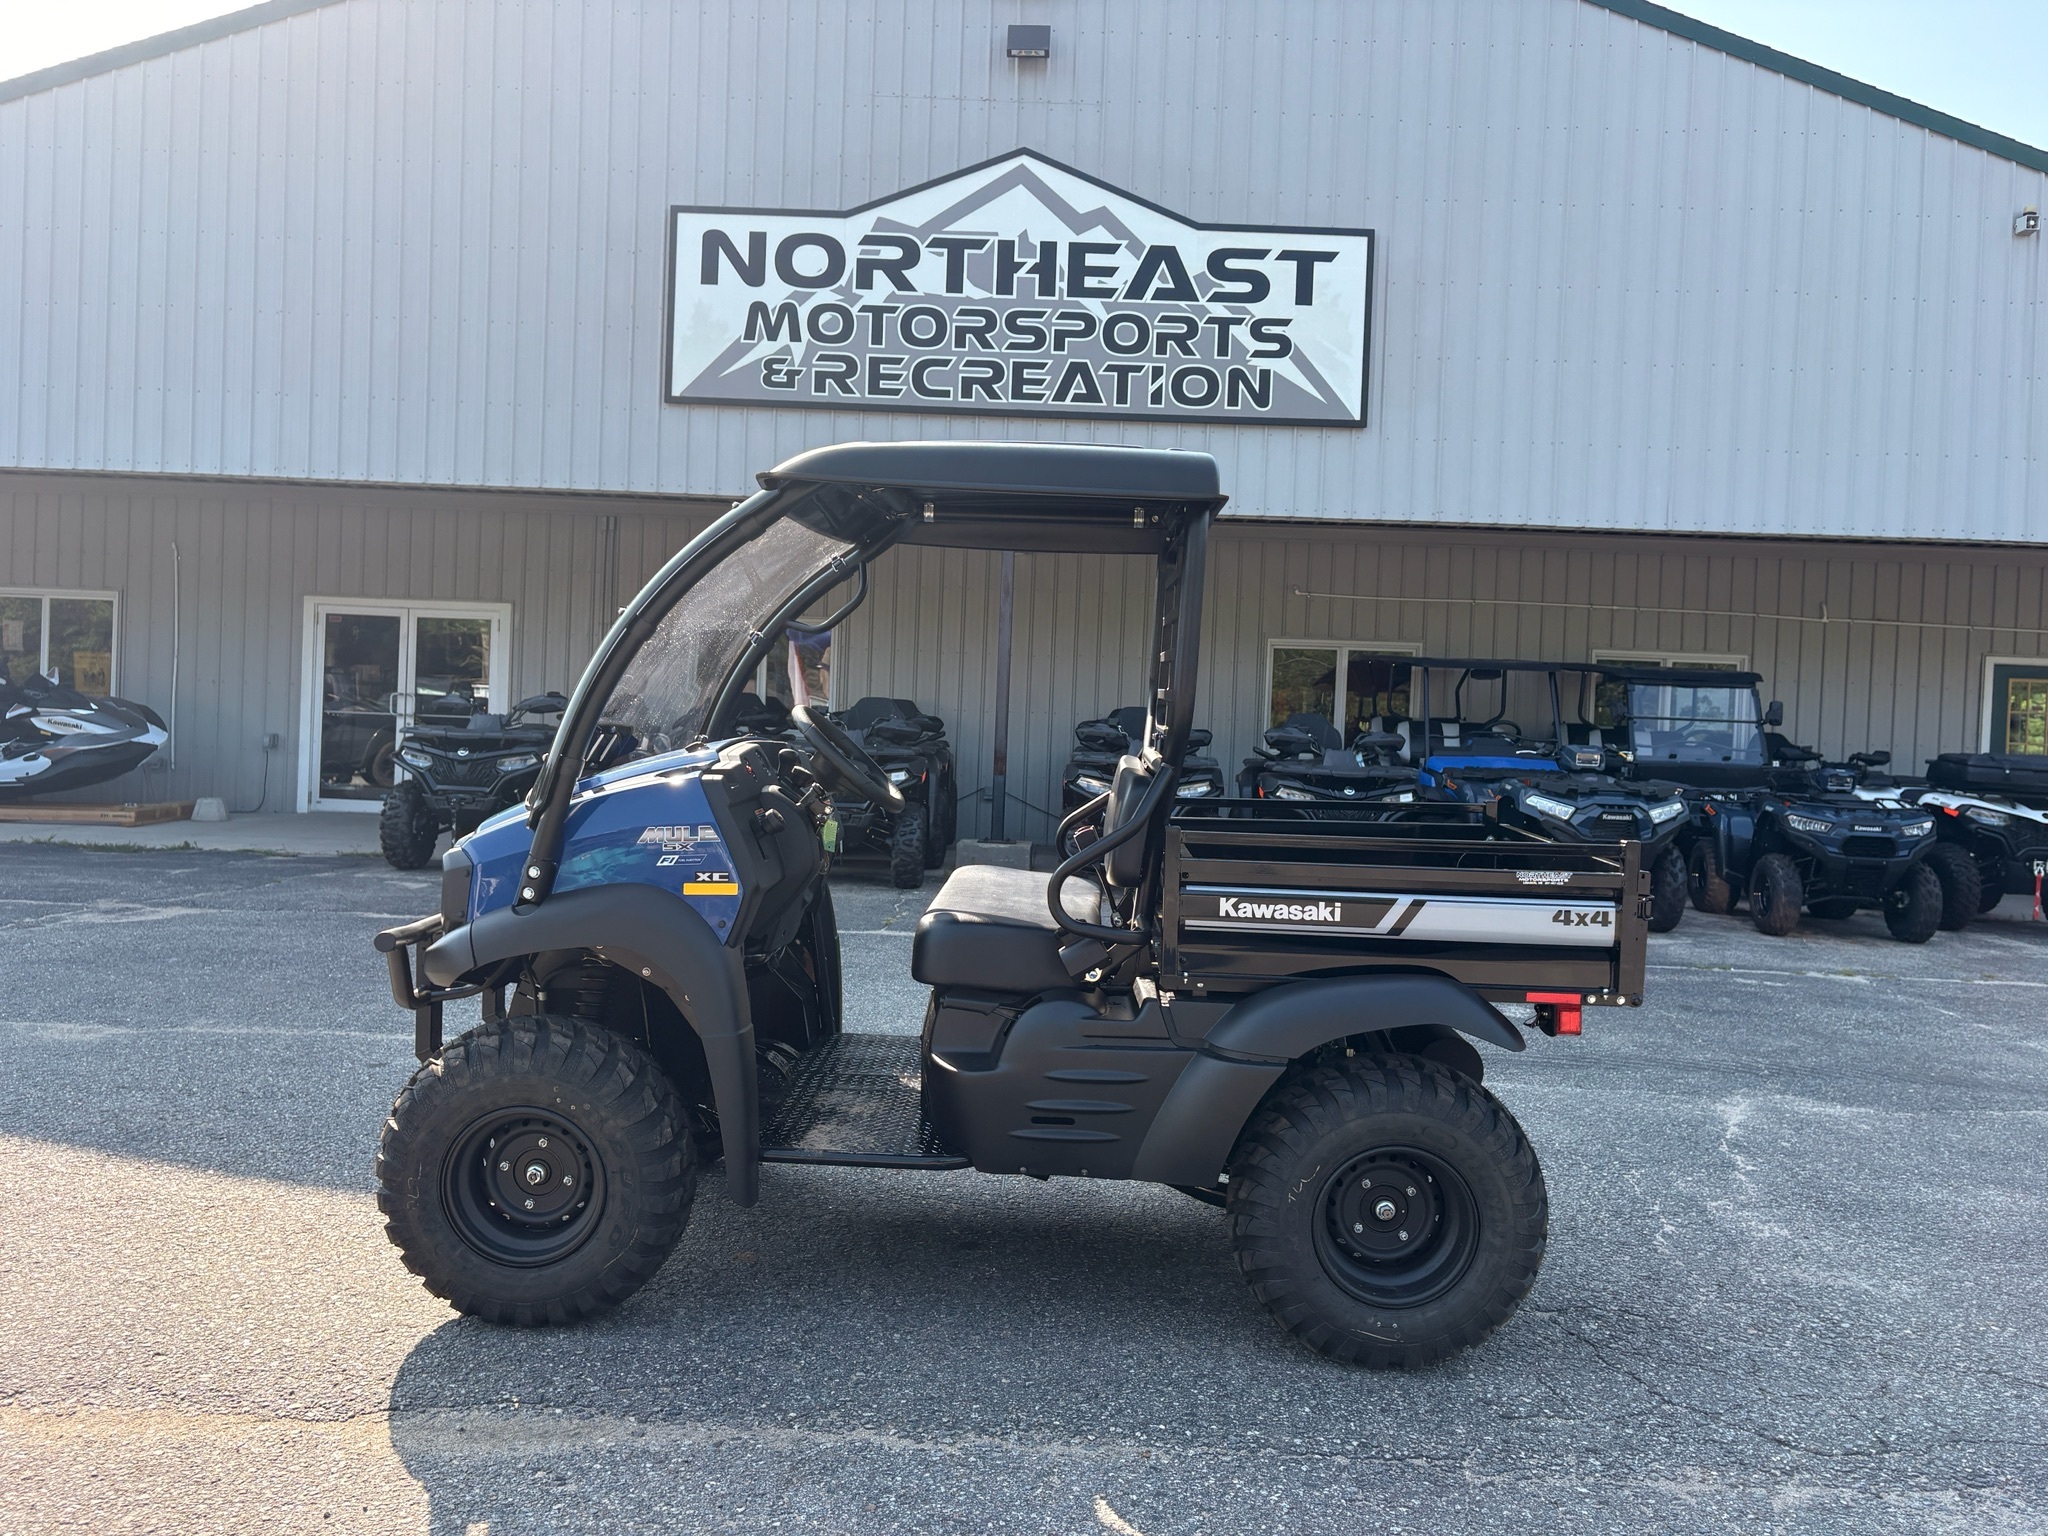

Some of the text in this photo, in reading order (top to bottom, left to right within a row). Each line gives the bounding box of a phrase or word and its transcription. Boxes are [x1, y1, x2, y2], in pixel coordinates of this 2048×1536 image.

[700, 229, 1340, 306] NORTHEAST
[742, 300, 1294, 359] MOTORSPORTS
[47, 718, 83, 730] Kawasaki
[1602, 813, 1632, 821] Kawasaki
[637, 825, 721, 844] MULE
[663, 842, 694, 852] SX
[696, 872, 729, 882] XC
[1219, 897, 1342, 922] Kawasaki
[1552, 909, 1612, 927] 4x4
